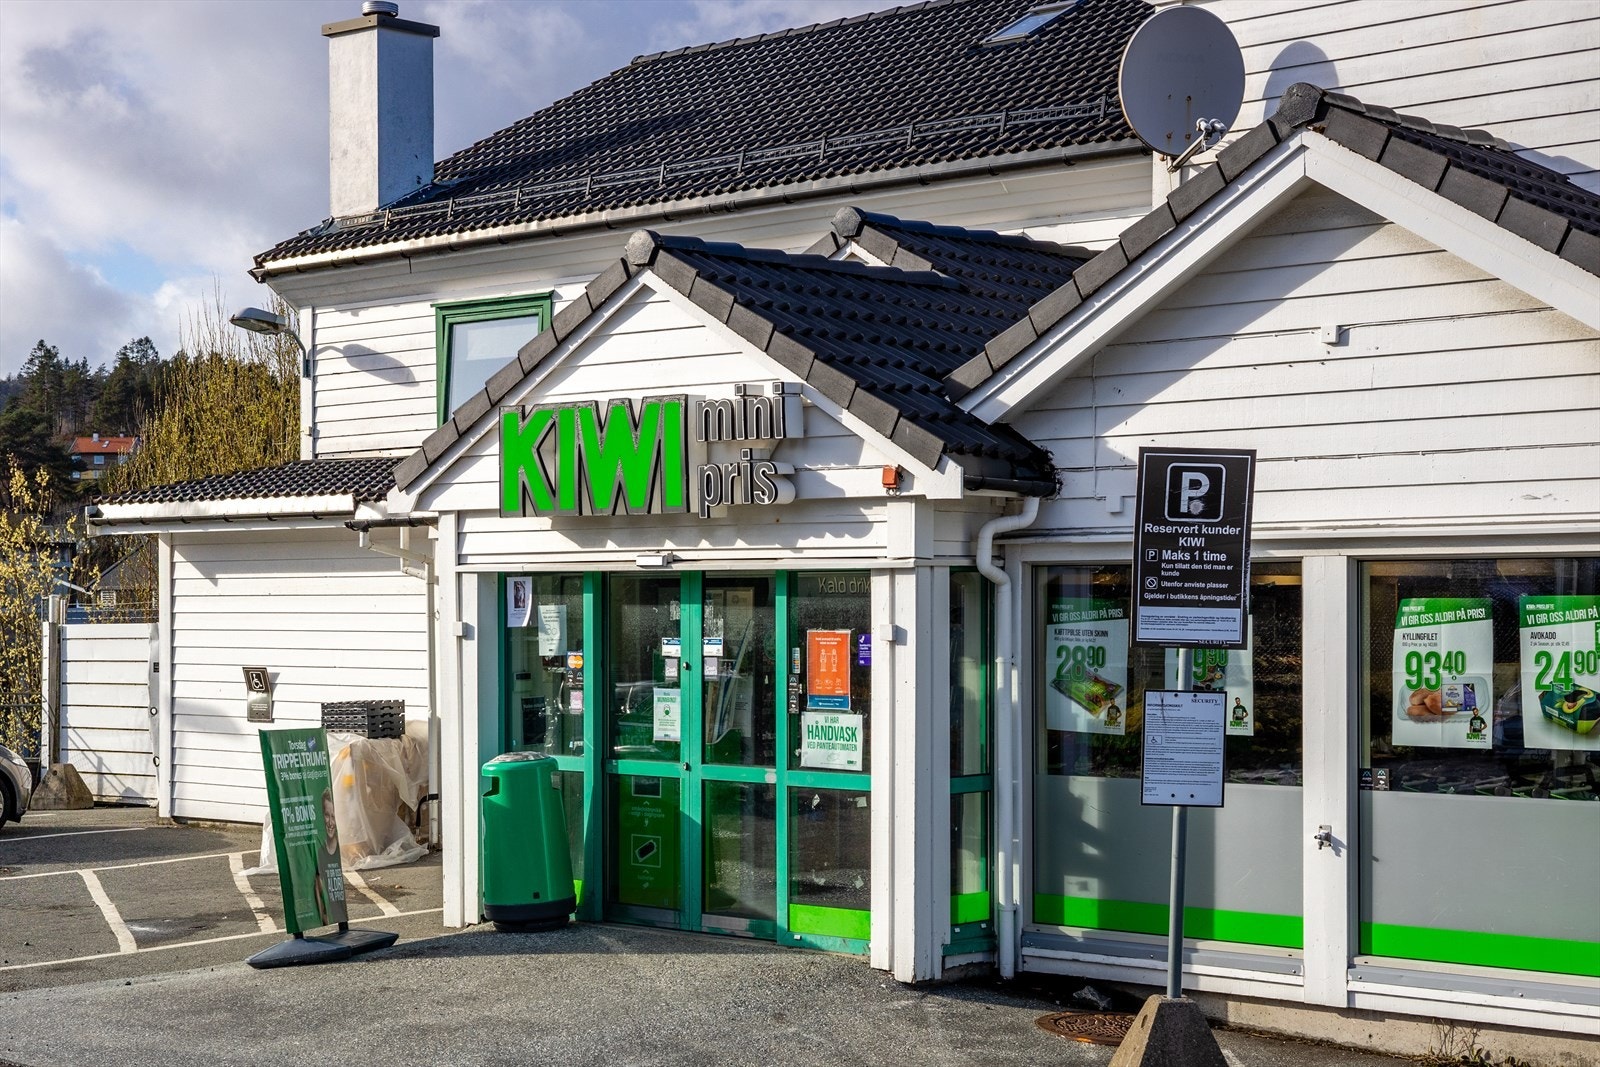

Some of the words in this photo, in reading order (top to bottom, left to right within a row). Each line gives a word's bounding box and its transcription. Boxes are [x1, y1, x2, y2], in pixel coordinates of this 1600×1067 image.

[696, 382, 786, 442] mini
[500, 394, 689, 517] KIWI
[697, 448, 780, 519] pris
[1180, 471, 1210, 513] P
[1145, 523, 1199, 535] Reservert
[1201, 524, 1241, 535] kunder
[1179, 537, 1205, 547] KIWI
[1162, 550, 1191, 561] Maks
[1194, 551, 1200, 561] 1
[1203, 550, 1227, 562] time
[818, 576, 847, 594] Kald
[1206, 582, 1229, 590] plasser
[1144, 592, 1166, 600] Gjelder
[1200, 593, 1238, 602] åpningstider
[1052, 614, 1059, 622] VI
[1060, 612, 1070, 622] GIR
[1070, 612, 1080, 620] OSS
[1081, 610, 1099, 620] ALDRI
[1100, 608, 1108, 618] PÅ
[1108, 608, 1124, 618] PRIS!
[1401, 616, 1408, 626] VI
[1409, 614, 1420, 626] GIR
[1420, 614, 1434, 624] OSS
[1435, 611, 1456, 623] ALDRI
[1456, 608, 1467, 621] PÅ
[1468, 608, 1486, 619] PRIS!
[1527, 614, 1534, 625] VI
[1536, 613, 1548, 624] GIR
[1550, 611, 1564, 622] OSS
[1565, 609, 1586, 622] ALDRI
[1588, 605, 1598, 618] PÅ
[1082, 629, 1094, 637] UTEN
[1094, 630, 1108, 638] SKINN
[1402, 632, 1438, 640] KYLLINGFILET
[1530, 632, 1556, 640] AVOKADO
[807, 720, 858, 742] HÅNDVASK
[288, 740, 306, 750] Torsdag
[816, 742, 858, 752] PANTEAUTOMATEN
[272, 751, 327, 770] TRIPPELTRUMF
[280, 772, 289, 780] 3%
[290, 772, 302, 780] bonus
[296, 805, 316, 822] BONUS
